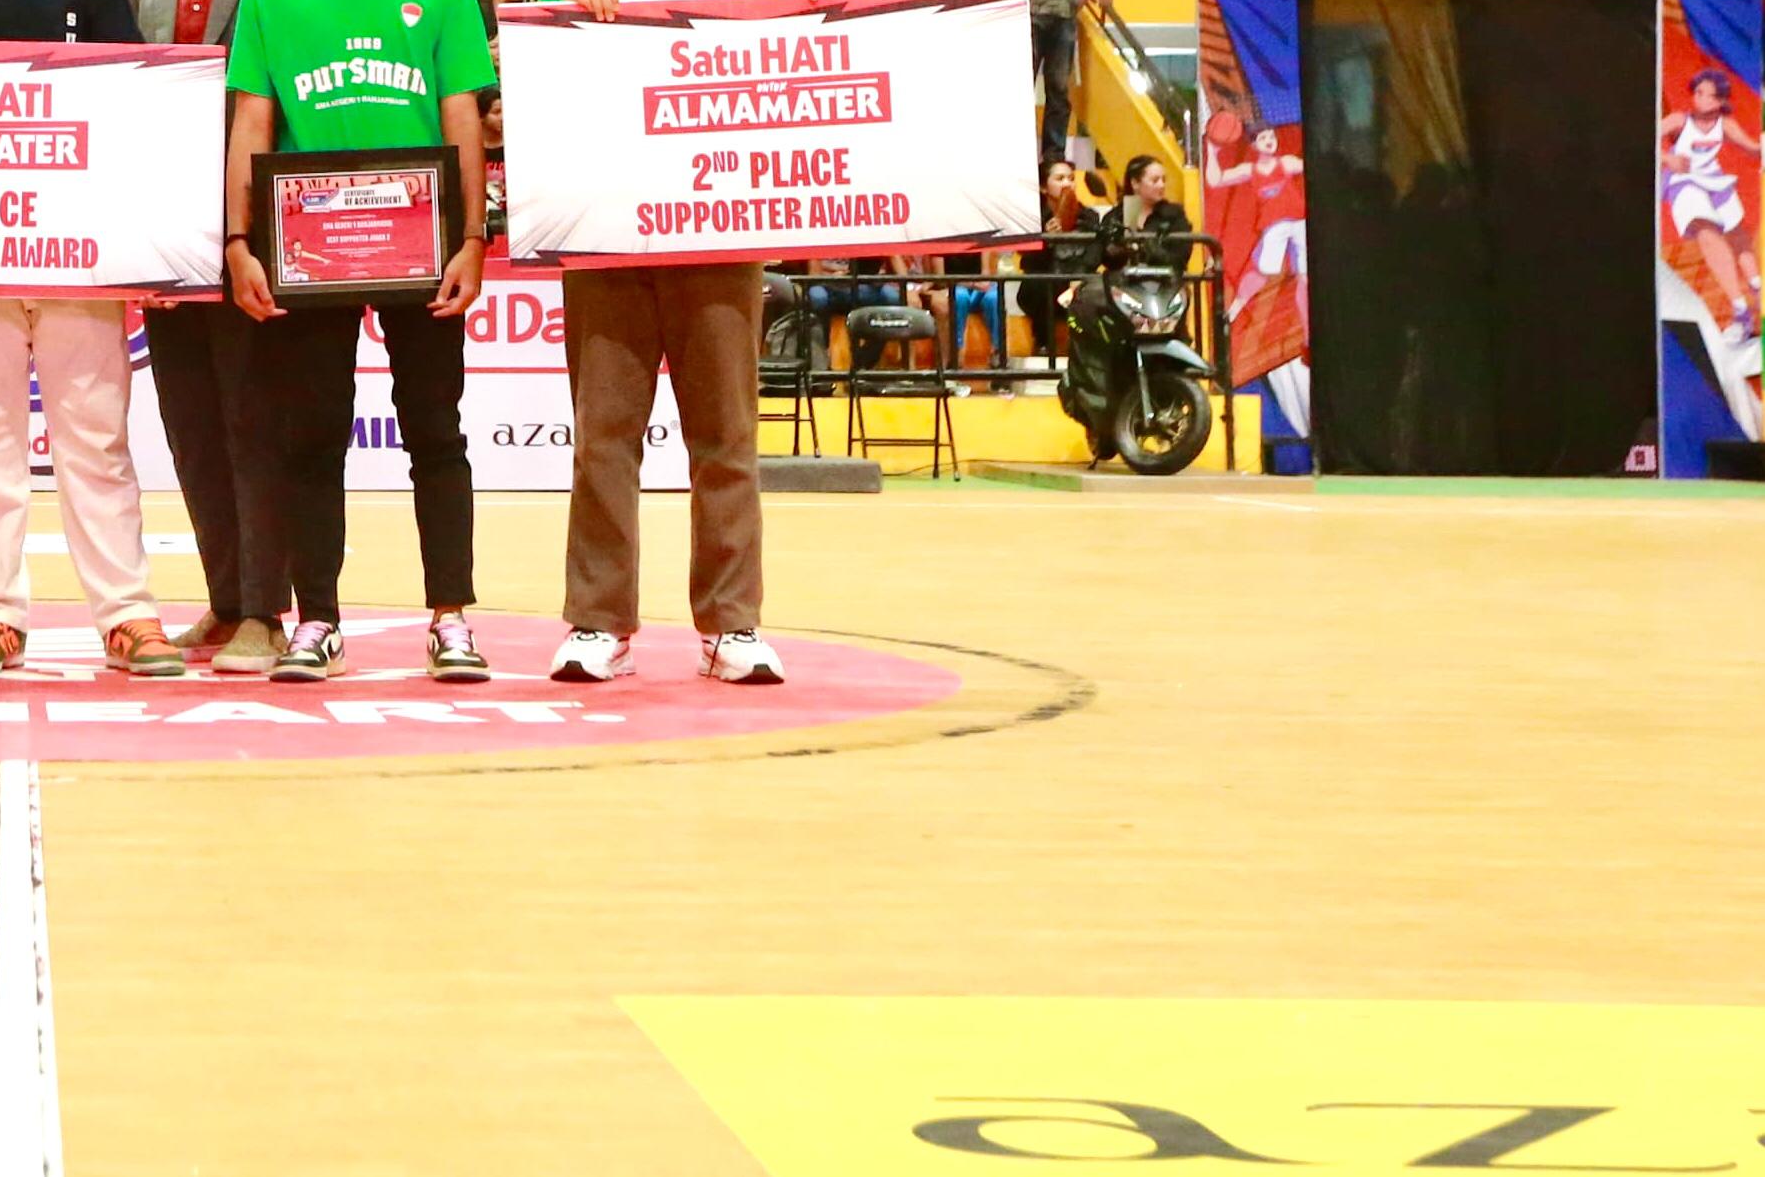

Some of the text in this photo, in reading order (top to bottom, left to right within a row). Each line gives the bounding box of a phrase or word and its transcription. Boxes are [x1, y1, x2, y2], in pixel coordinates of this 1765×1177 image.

[670, 34, 850, 78] Satu HATI
[652, 86, 884, 130] ALMAMATER
[691, 147, 852, 192] 2ND PLACE
[636, 192, 911, 237] SUPPORTER AWARD
[1, 236, 99, 270] AWARD
[506, 293, 566, 344] Da
